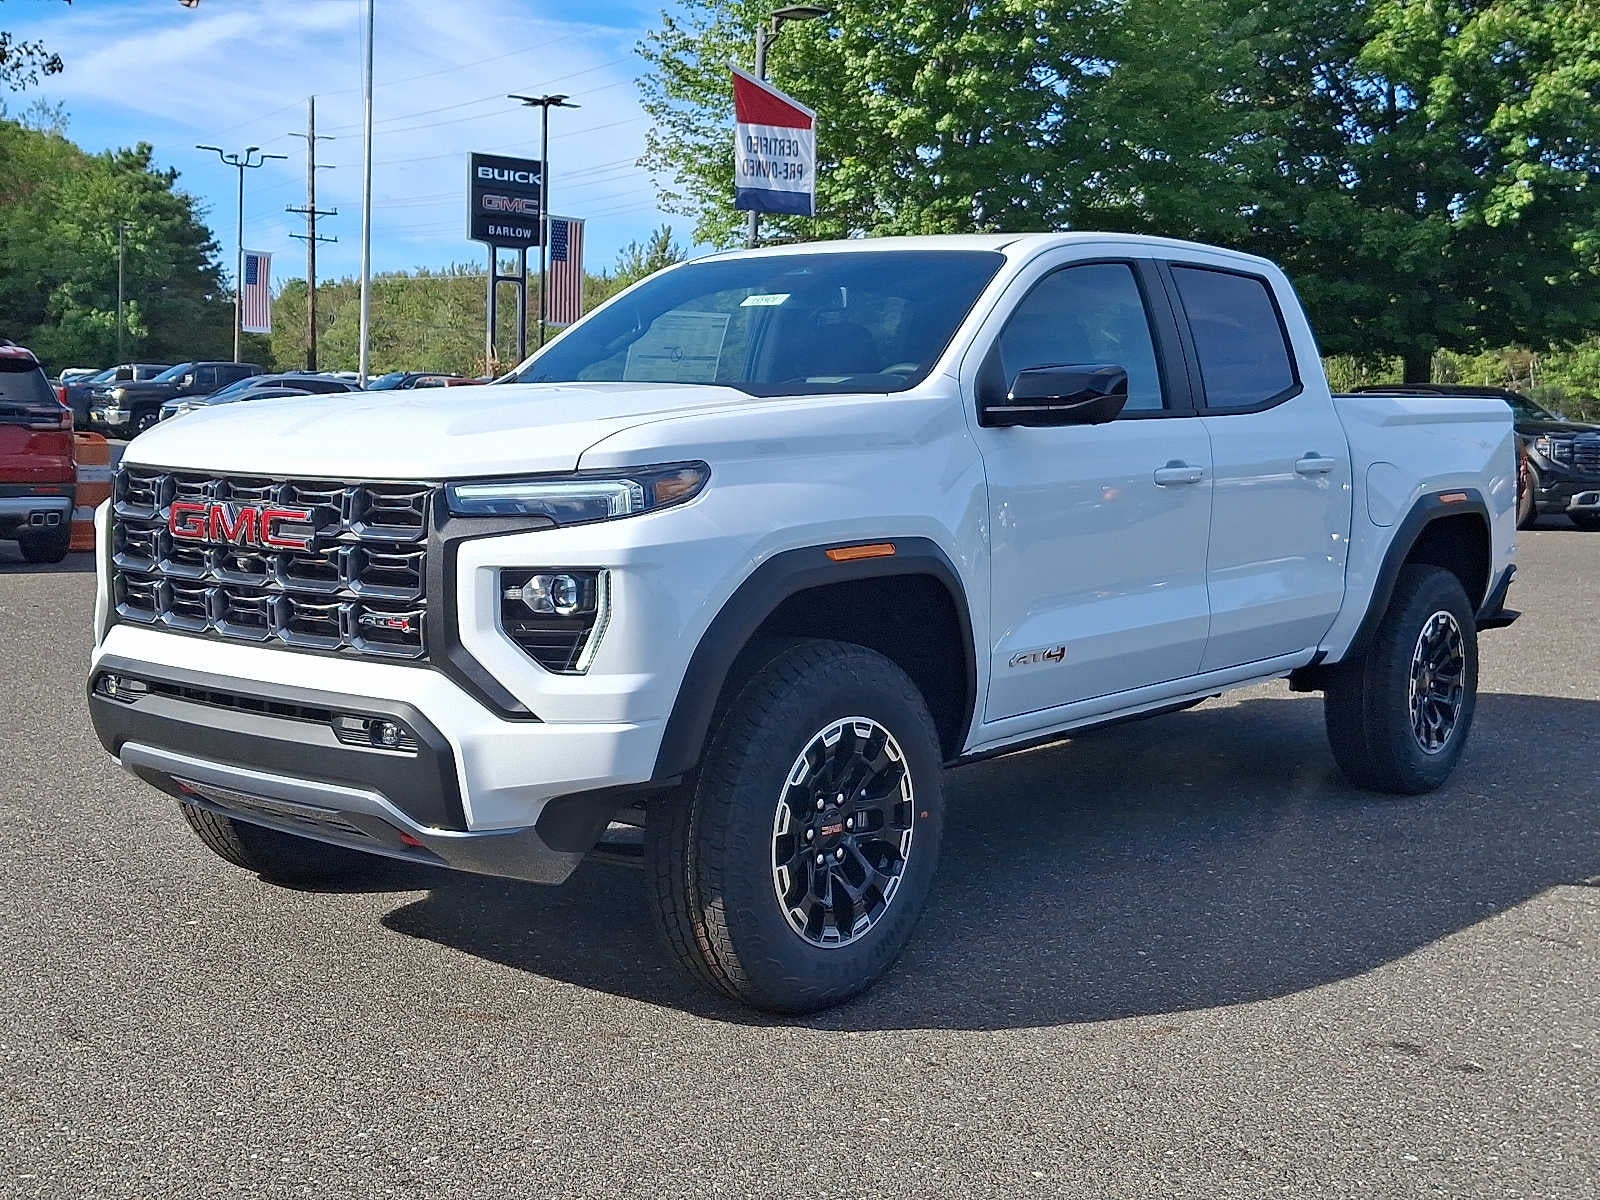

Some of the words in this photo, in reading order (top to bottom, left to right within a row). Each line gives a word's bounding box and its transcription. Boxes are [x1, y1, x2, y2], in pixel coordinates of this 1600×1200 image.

[478, 166, 542, 185] BUICK
[482, 194, 539, 215] GMC
[488, 225, 532, 239] BARLOW
[169, 500, 316, 551] GMC
[358, 613, 410, 634] AT4
[1009, 645, 1066, 667] AT4
